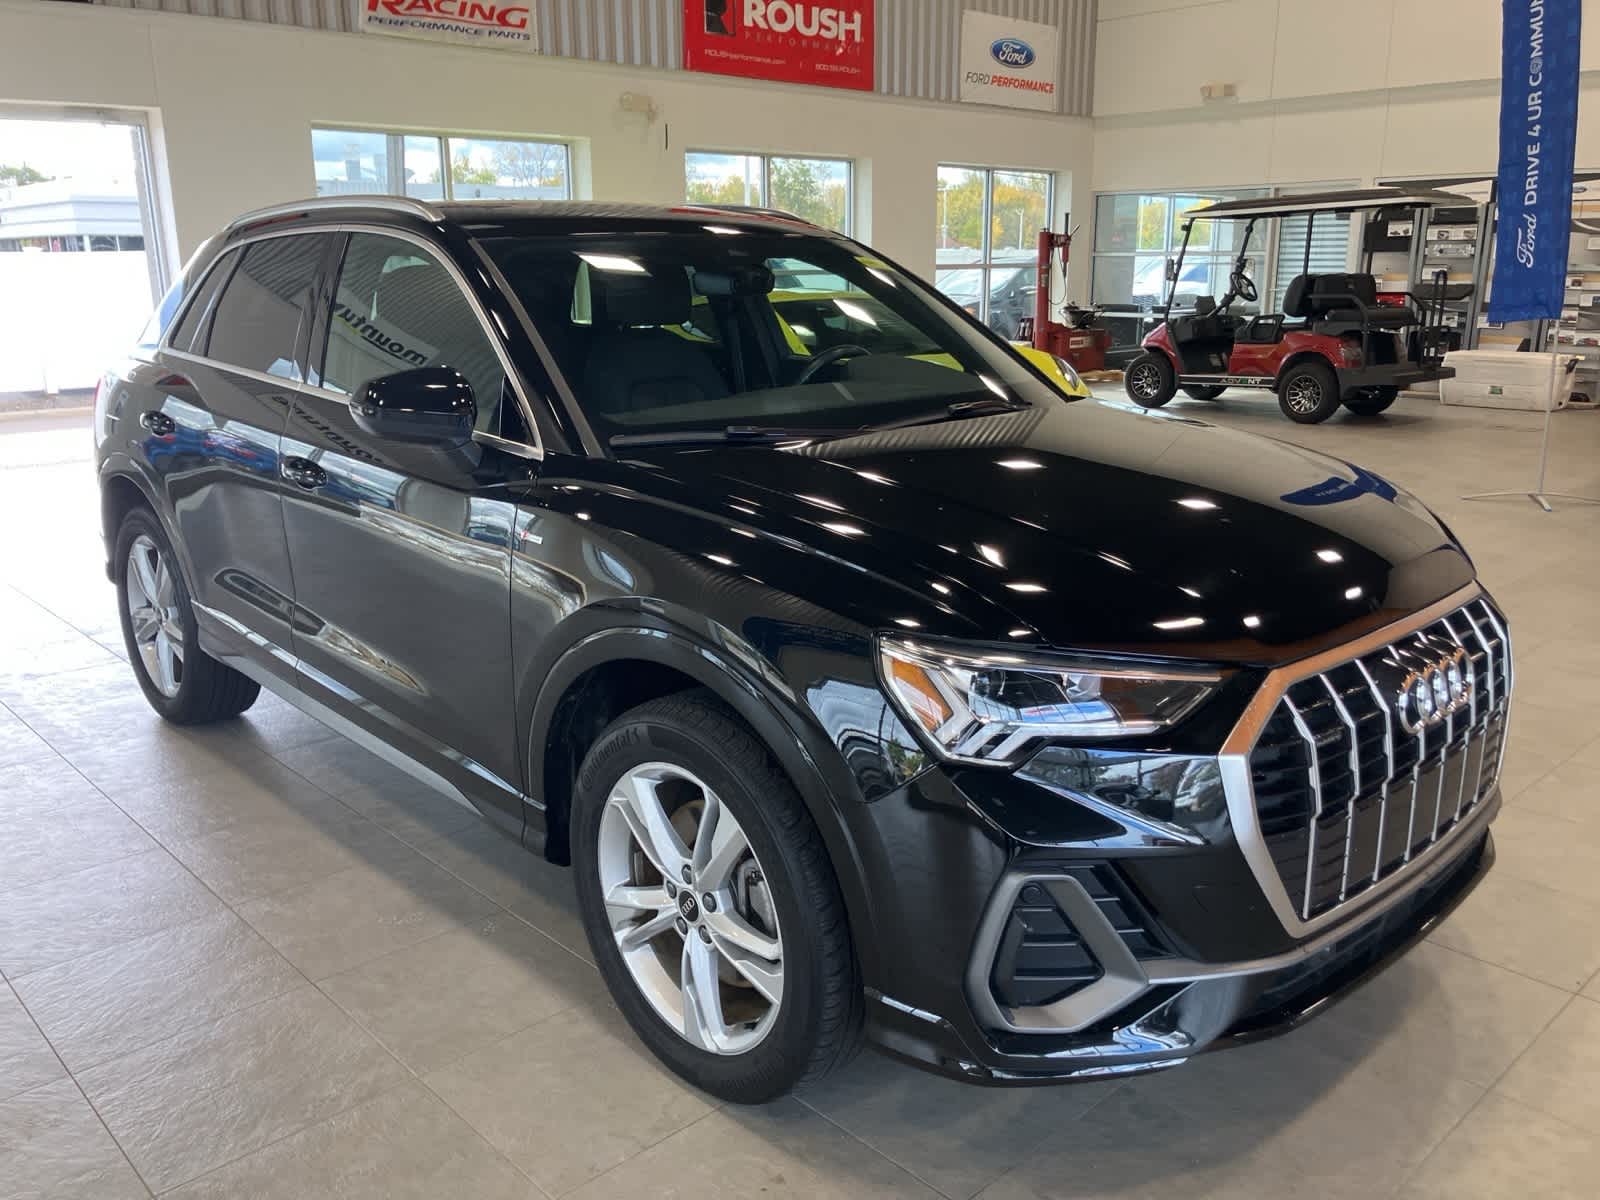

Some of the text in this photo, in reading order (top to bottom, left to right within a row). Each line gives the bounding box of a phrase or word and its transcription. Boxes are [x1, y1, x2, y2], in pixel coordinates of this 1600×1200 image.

[367, 0, 529, 29] RACING
[368, 15, 531, 41] PERFORMANCE PARTS
[743, 0, 862, 43] ROUSH
[999, 42, 1027, 64] Ford
[966, 71, 1055, 94] FORD PERFORMANCE
[1527, 91, 1543, 121] UR
[1527, 124, 1541, 137] 4
[1524, 142, 1541, 206] DRIVE
[1516, 213, 1537, 268] Ford
